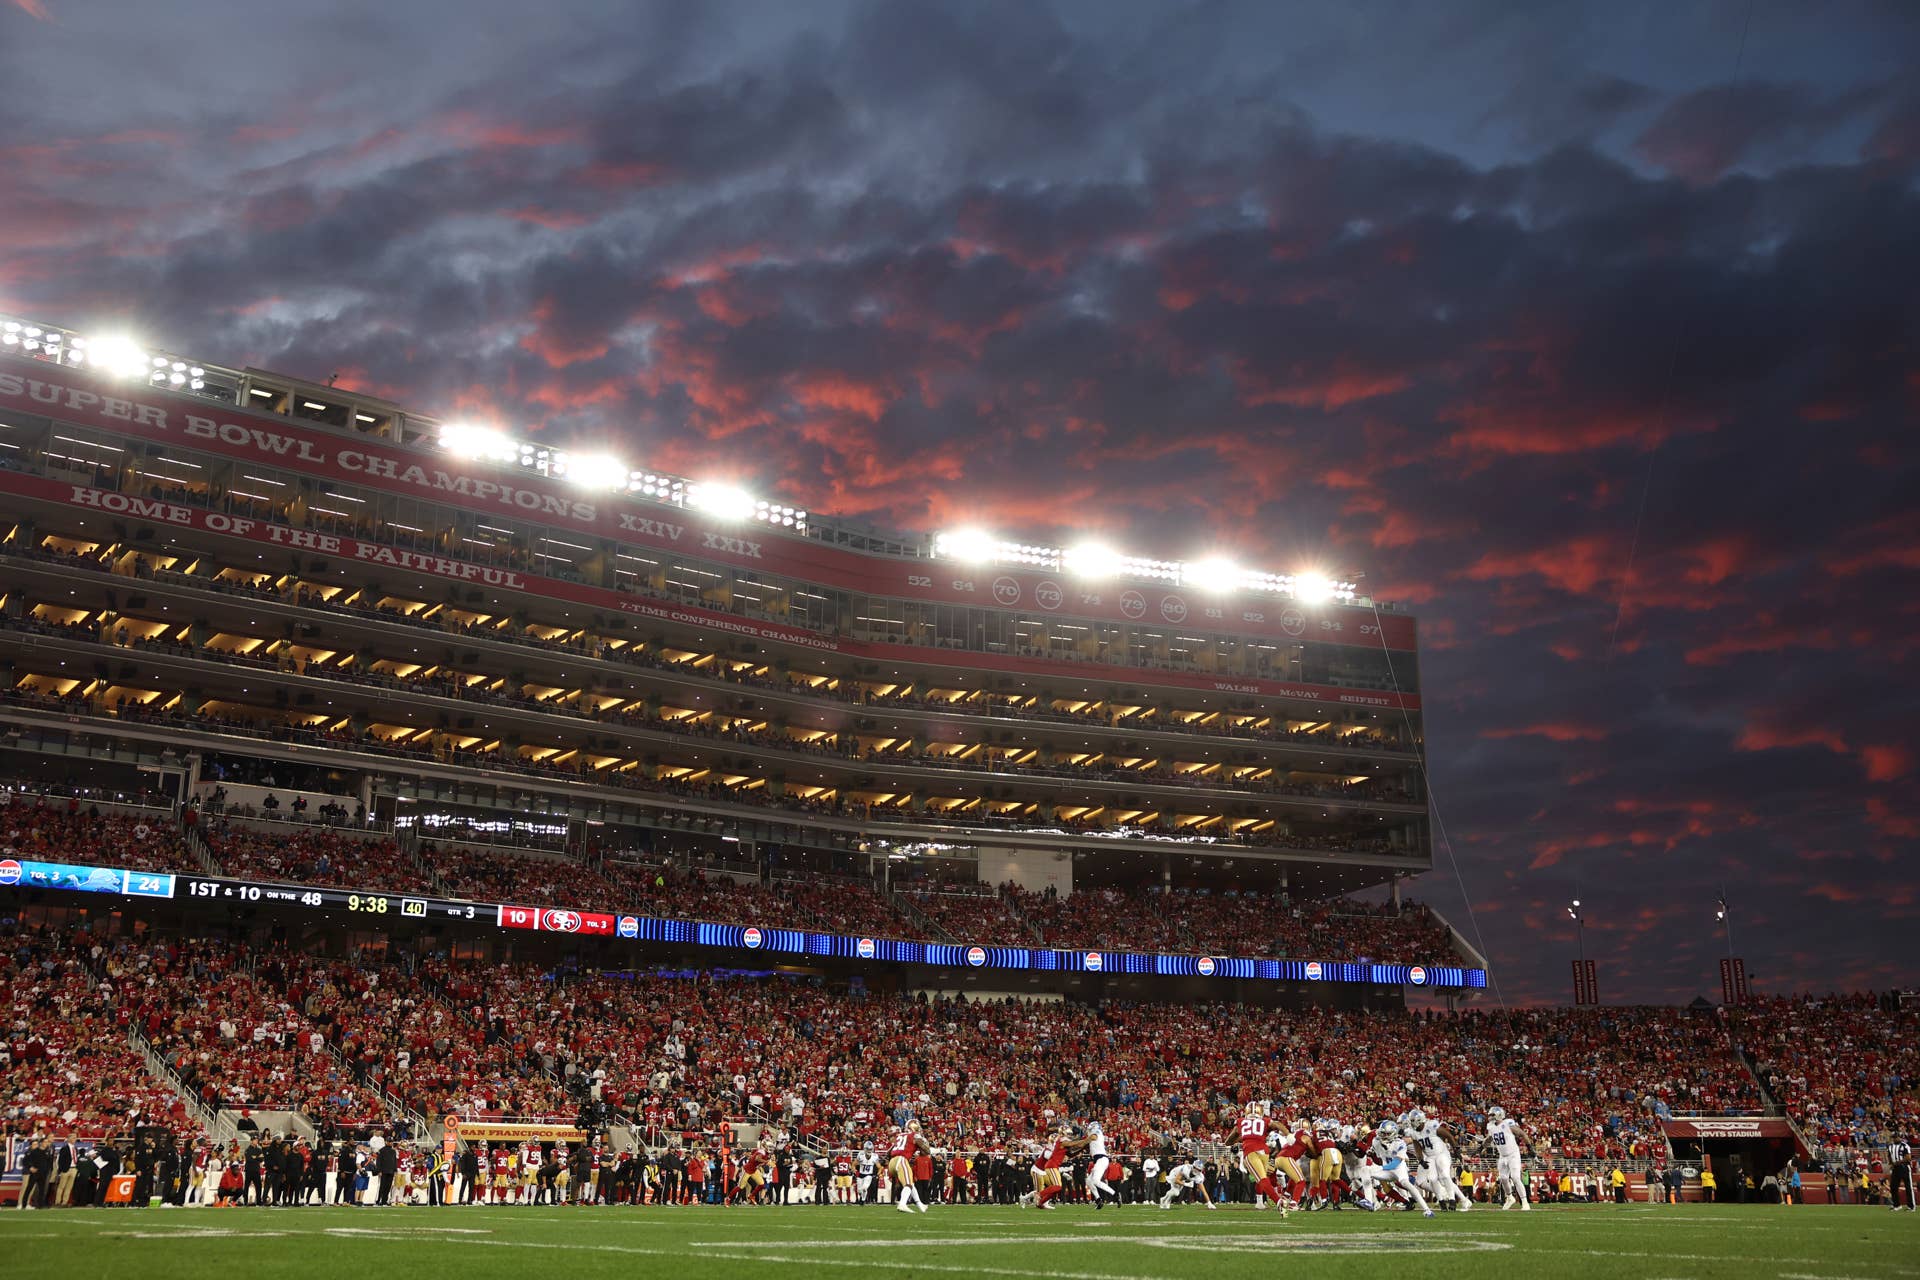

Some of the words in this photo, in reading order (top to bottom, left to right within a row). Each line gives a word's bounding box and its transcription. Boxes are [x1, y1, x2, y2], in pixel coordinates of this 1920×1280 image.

[0, 374, 168, 429] SUPER
[184, 414, 325, 464] BOWL
[337, 449, 597, 522] CHAMPIONS
[617, 513, 685, 541] XXIV
[702, 532, 763, 560] XXIX
[70, 486, 192, 525] HOME
[205, 513, 255, 536] OF
[265, 525, 341, 553] THE
[354, 541, 526, 590] FAITHFUL
[908, 575, 932, 588] 52
[995, 585, 1018, 597] 70
[1038, 589, 1061, 601] 73
[619, 601, 668, 619] 7-TIME
[671, 611, 758, 636] CONFERENCE
[761, 629, 839, 651] CHAMPIONS
[1359, 624, 1379, 636] 97
[1214, 683, 1259, 694] WALSH
[1340, 695, 1390, 706] SEIFERT
[30, 871, 47, 879] TOL
[51, 871, 60, 881] 3
[138, 877, 161, 892] 24
[189, 881, 220, 897] 1ST
[224, 887, 233, 896] &
[239, 886, 261, 901] 10
[266, 891, 280, 899] ON
[280, 892, 296, 900] THE
[300, 892, 322, 906] 48
[348, 894, 388, 914] 9:38
[406, 902, 422, 915] 40
[447, 908, 462, 916] QTR
[465, 906, 475, 919] 3
[509, 910, 527, 924] 10
[586, 920, 600, 928] TOL
[601, 921, 607, 929] 3
[461, 1129, 486, 1137] SAN
[489, 1129, 553, 1138] FRANCISCO
[1241, 1119, 1264, 1136] 20
[1493, 1132, 1505, 1145] 68
[531, 1151, 540, 1161] 99
[839, 1162, 848, 1171] 53
[119, 1181, 131, 1195] G
